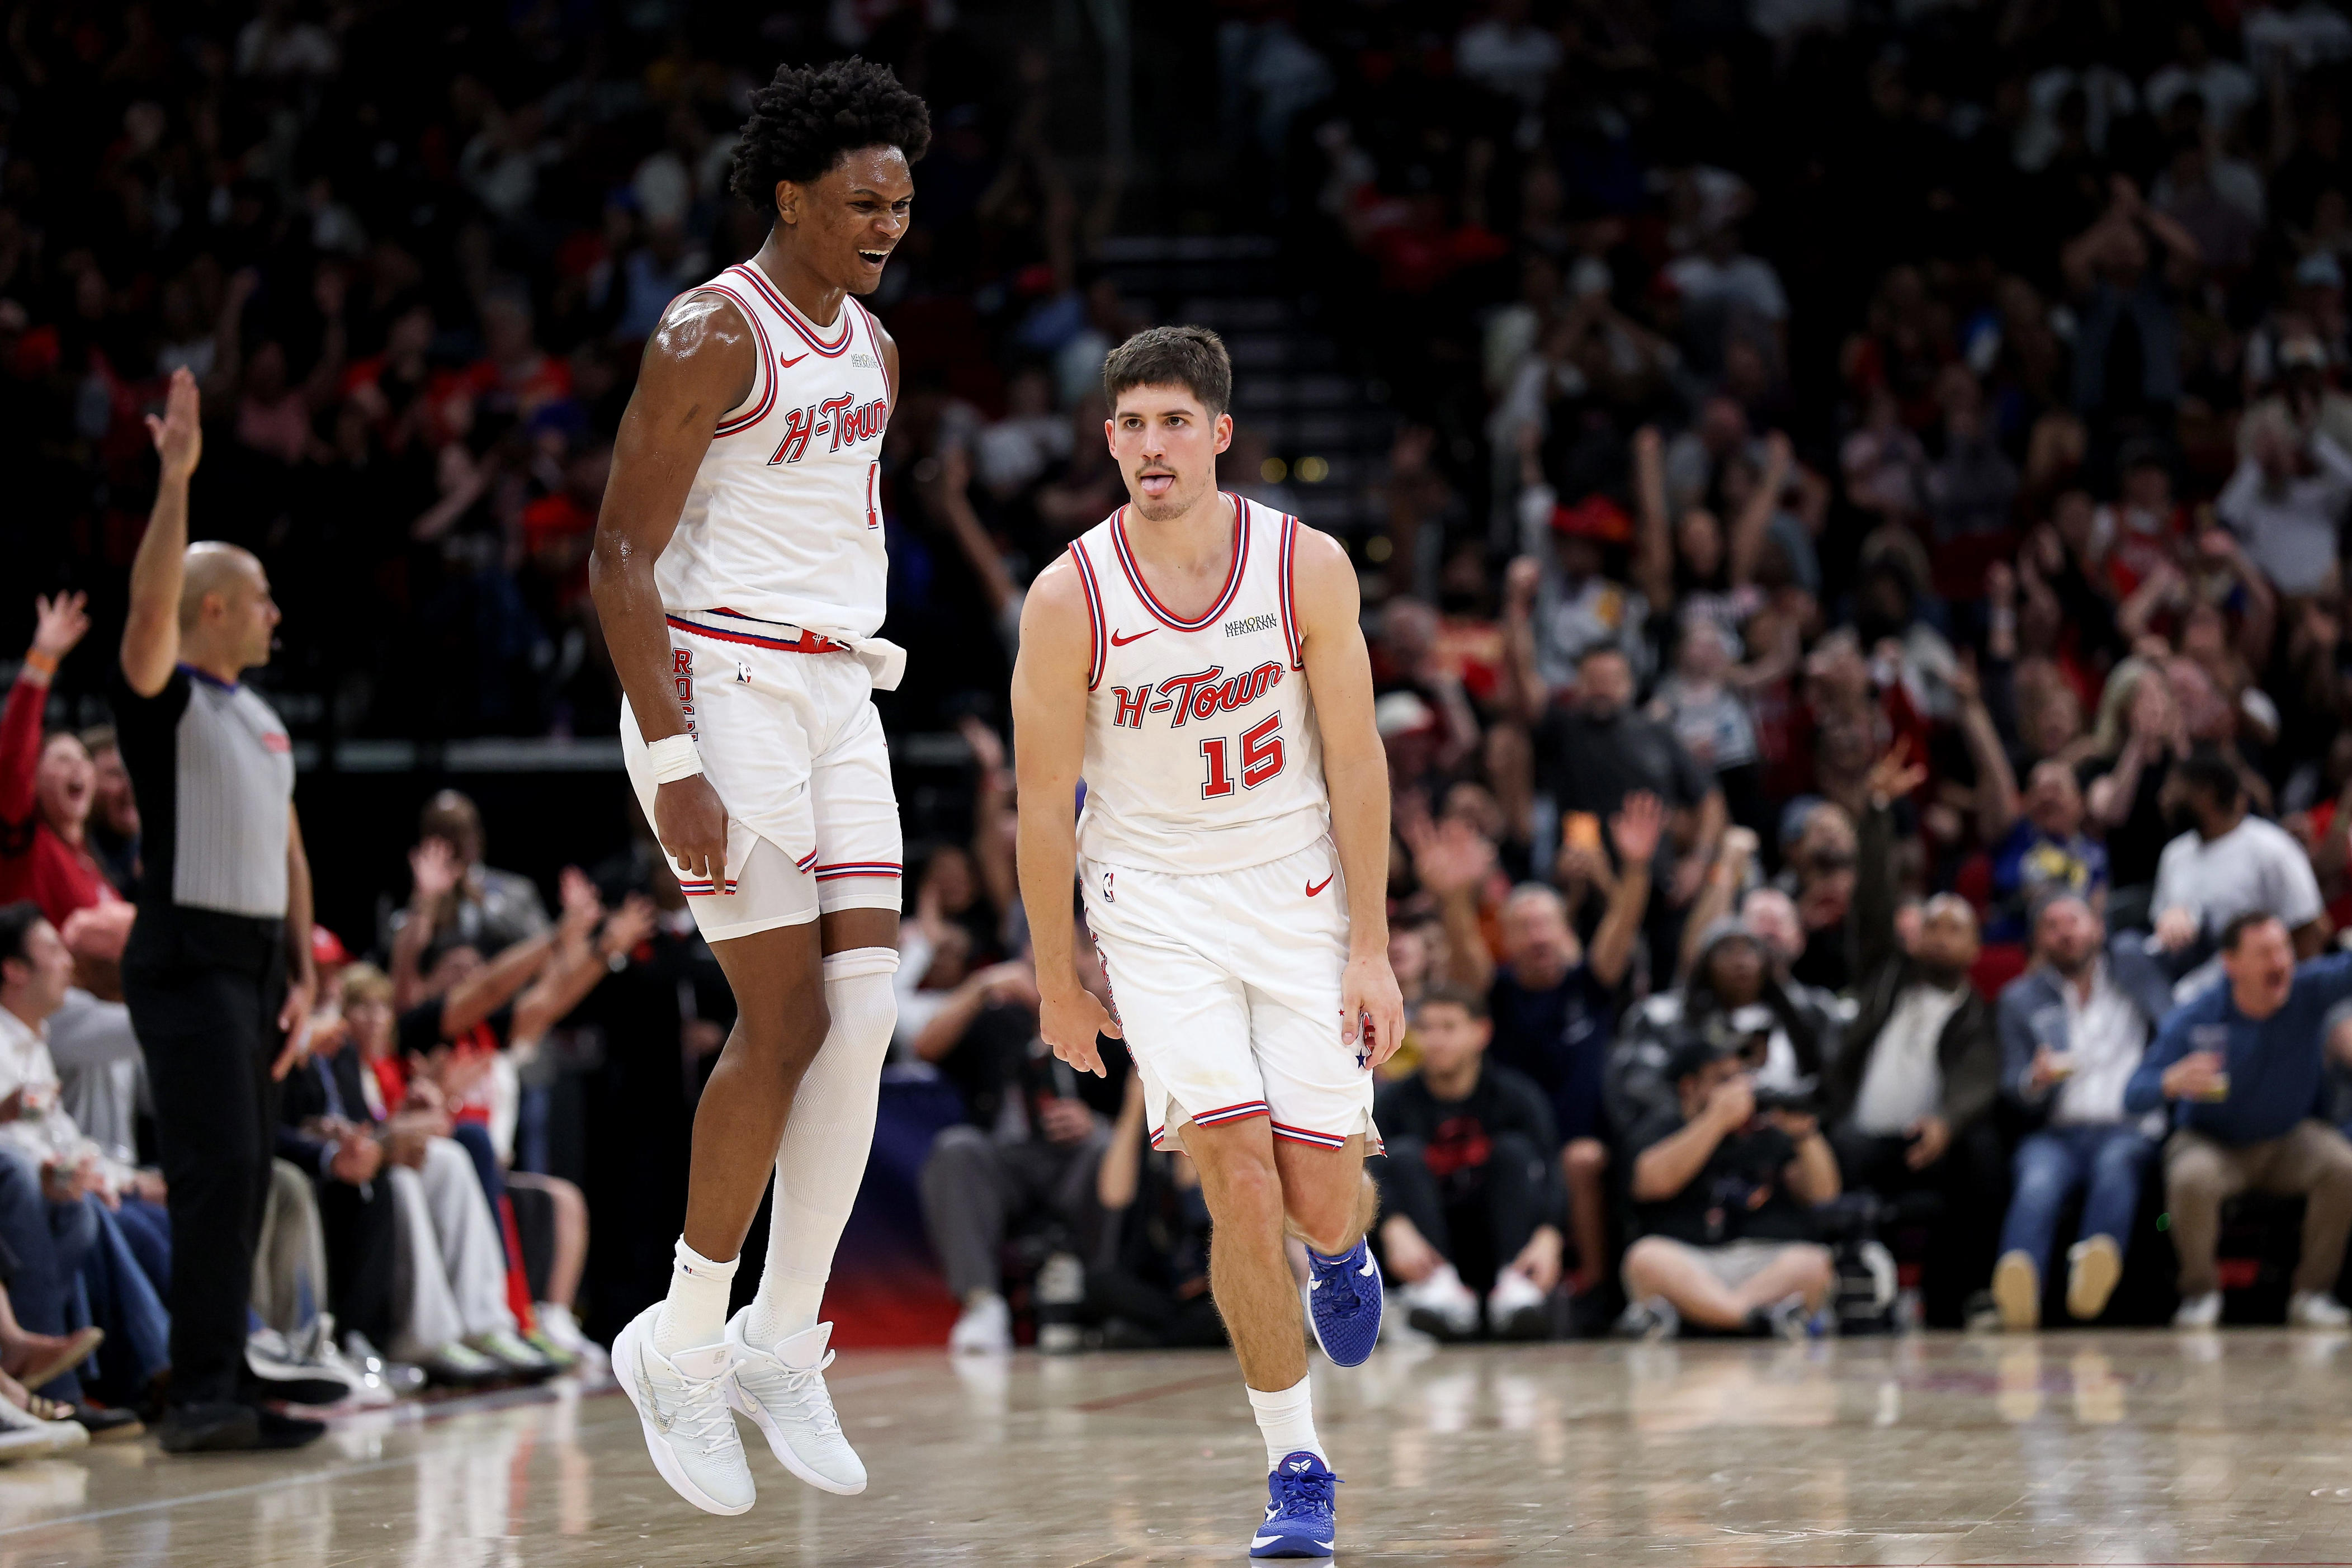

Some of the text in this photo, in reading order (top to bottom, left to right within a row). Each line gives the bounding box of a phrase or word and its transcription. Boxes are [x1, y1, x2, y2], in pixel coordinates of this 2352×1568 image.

[767, 391, 888, 465] H-Town
[866, 460, 879, 530] 1
[1225, 613, 1277, 631] MEMORIAL
[1226, 620, 1277, 637] HERMANN
[1111, 660, 1285, 729] H-Town
[1200, 711, 1286, 800] 15
